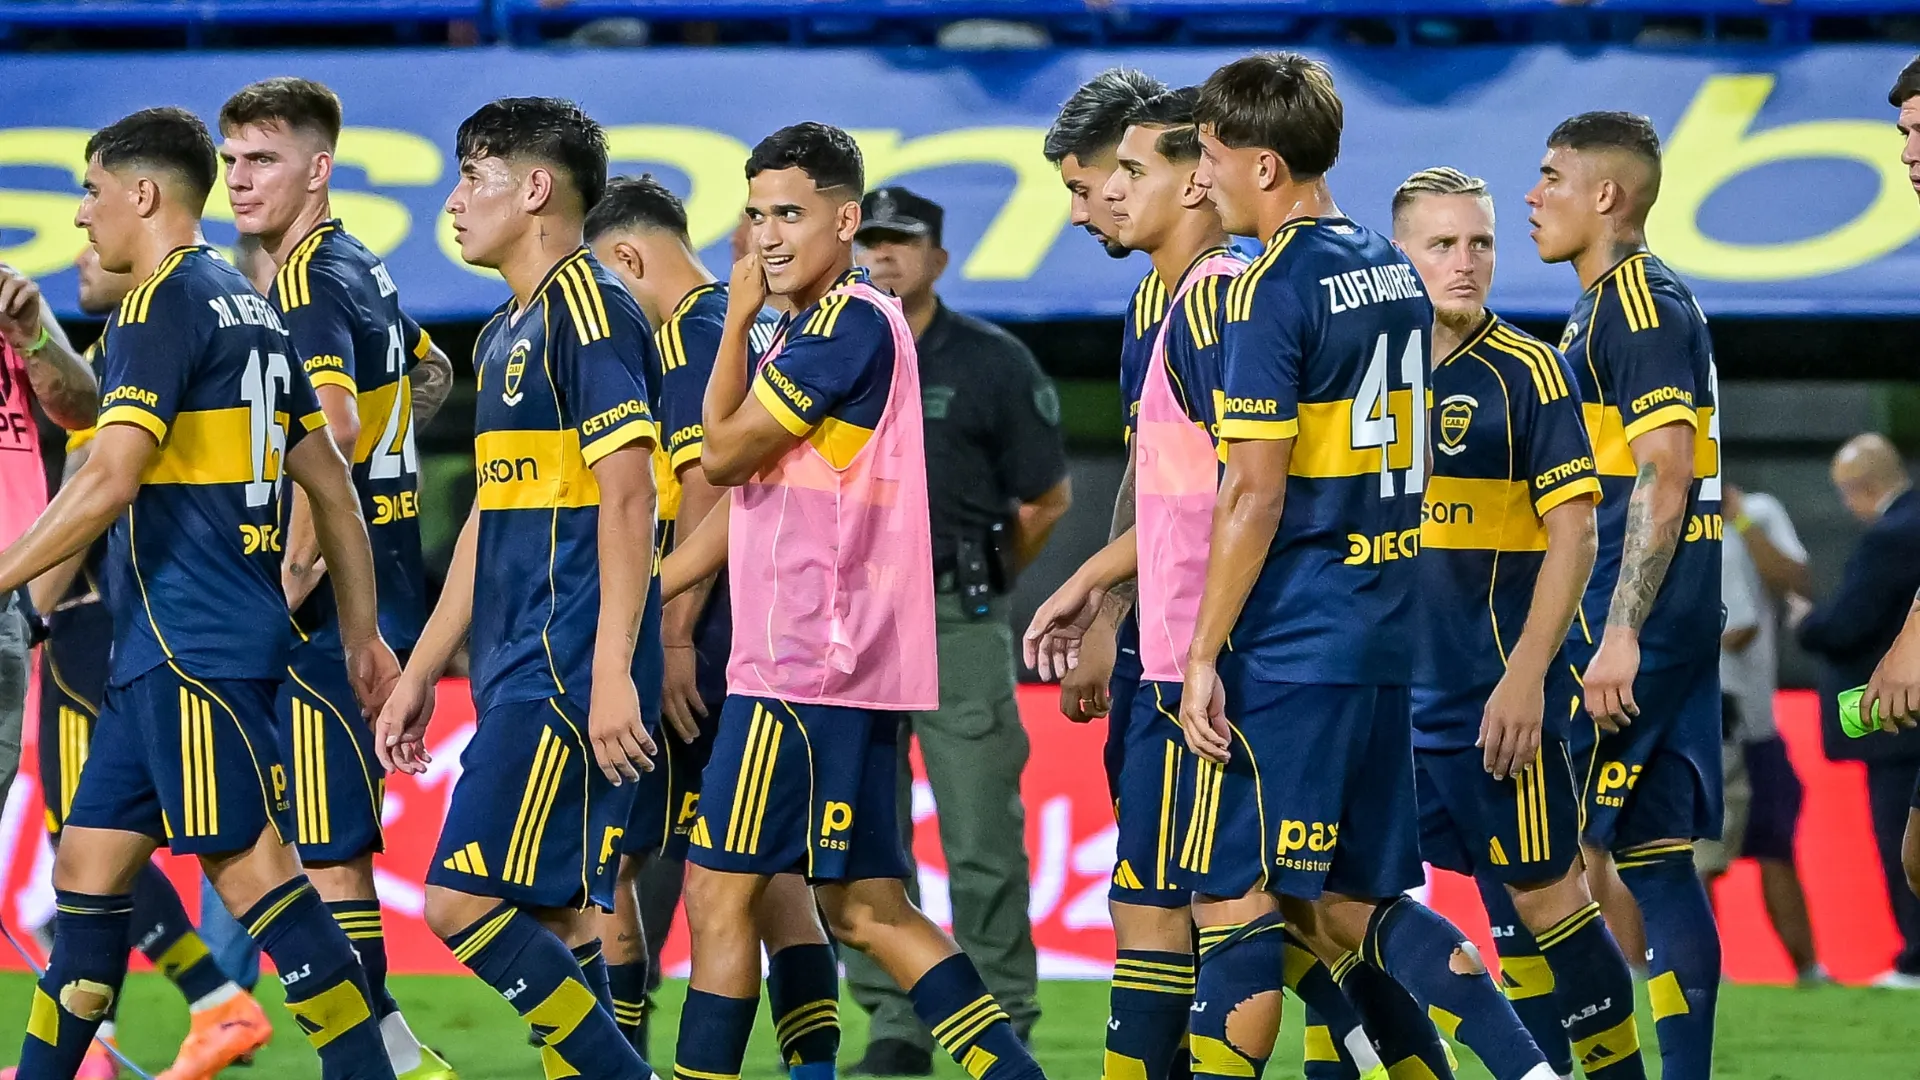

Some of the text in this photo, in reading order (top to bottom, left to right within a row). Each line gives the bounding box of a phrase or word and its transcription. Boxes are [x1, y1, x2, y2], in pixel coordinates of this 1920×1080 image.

[1319, 263, 1424, 315] ZUFIAURRE
[1352, 330, 1424, 498] 41
[1631, 386, 1693, 414] CETROGAR
[241, 350, 291, 508] 16
[1535, 456, 1594, 489] CETROG
